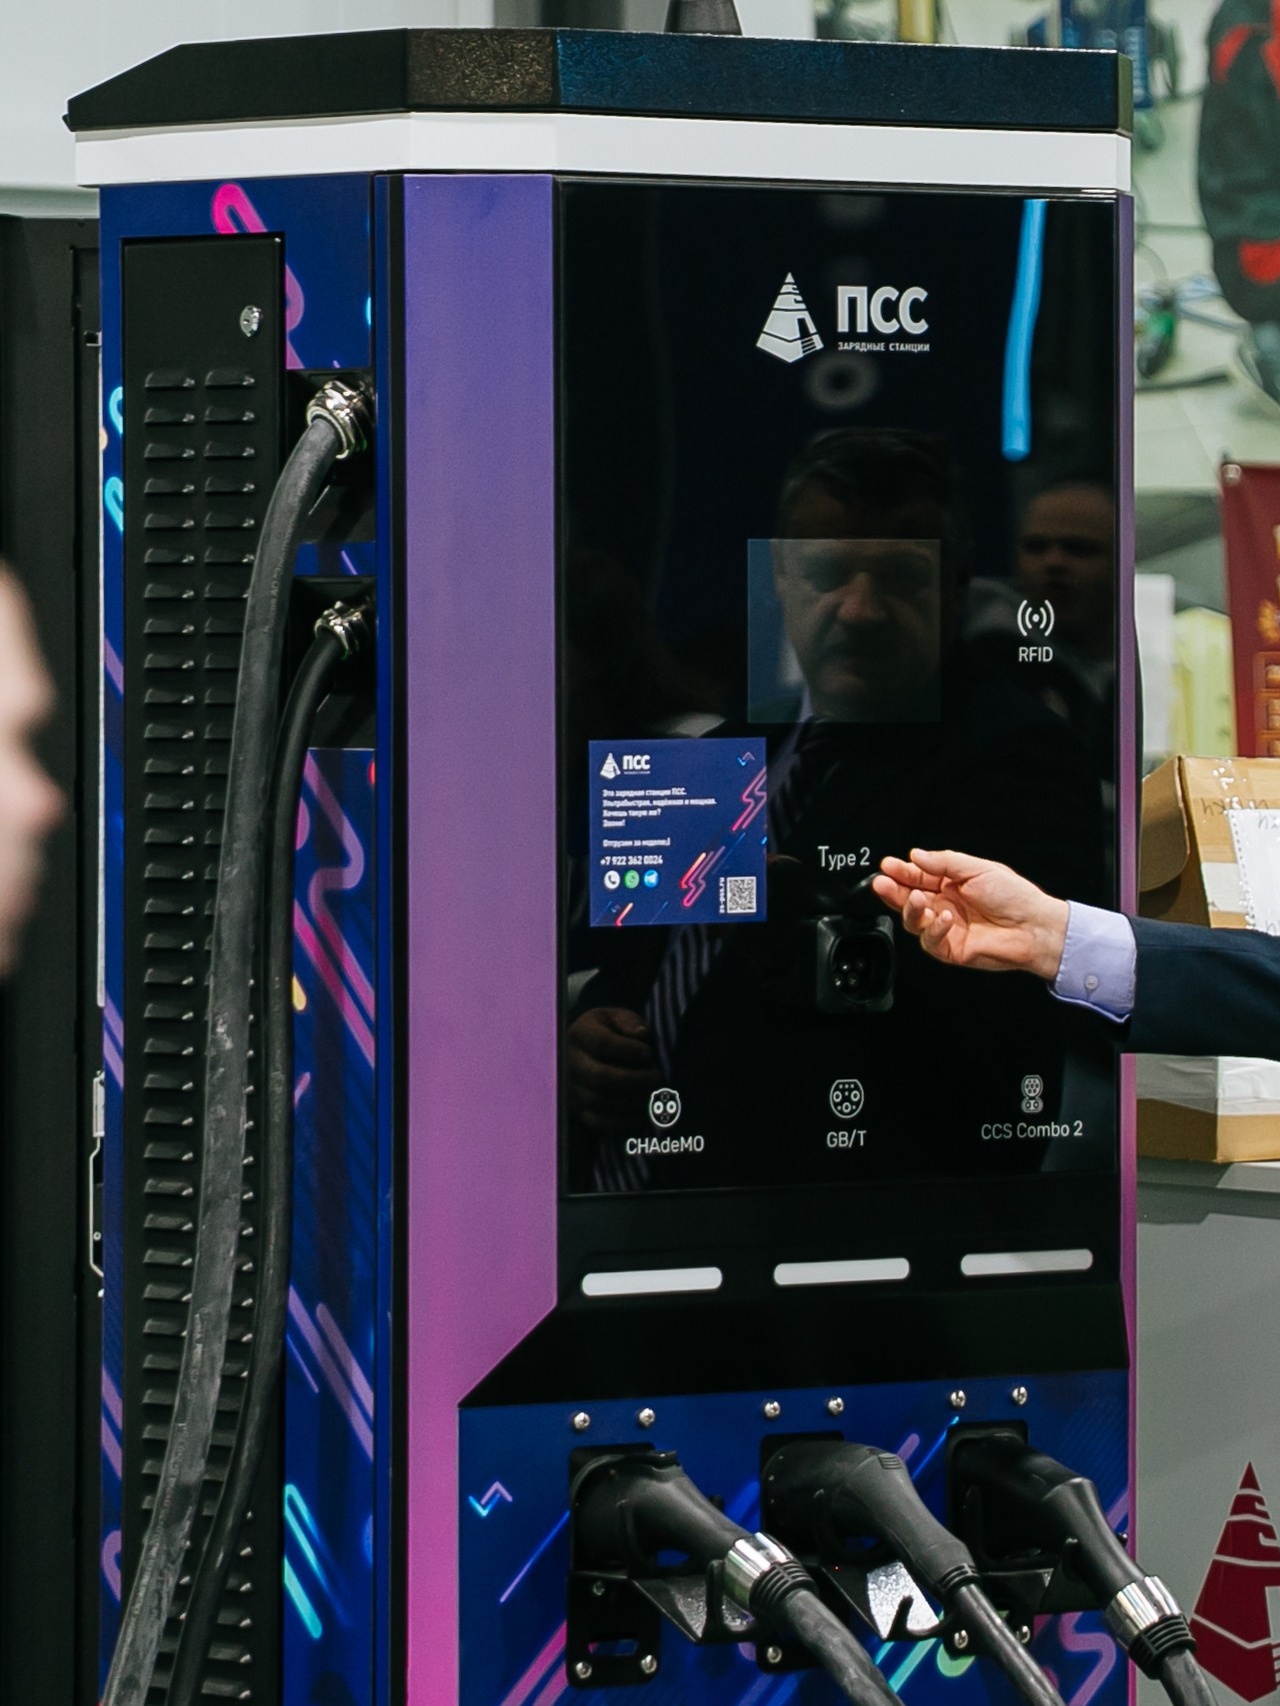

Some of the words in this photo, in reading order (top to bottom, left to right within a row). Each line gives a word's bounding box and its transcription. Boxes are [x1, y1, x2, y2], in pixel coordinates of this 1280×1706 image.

[837, 285, 929, 335] ПСС
[837, 341, 886, 352] ЗАРЯДНЫЕ
[889, 342, 930, 353] СТАНЦИИ
[1018, 646, 1054, 662] RFID
[622, 755, 651, 770] ПСС
[600, 856, 611, 865] +7
[611, 856, 626, 865] 922
[817, 845, 857, 871] Type
[859, 846, 871, 866] 2
[826, 1130, 868, 1149] GB/T
[981, 1122, 1013, 1140] CCS
[1016, 1121, 1070, 1139] Combo
[1074, 1120, 1084, 1137] 2
[625, 1135, 705, 1155] CHAdeMO
